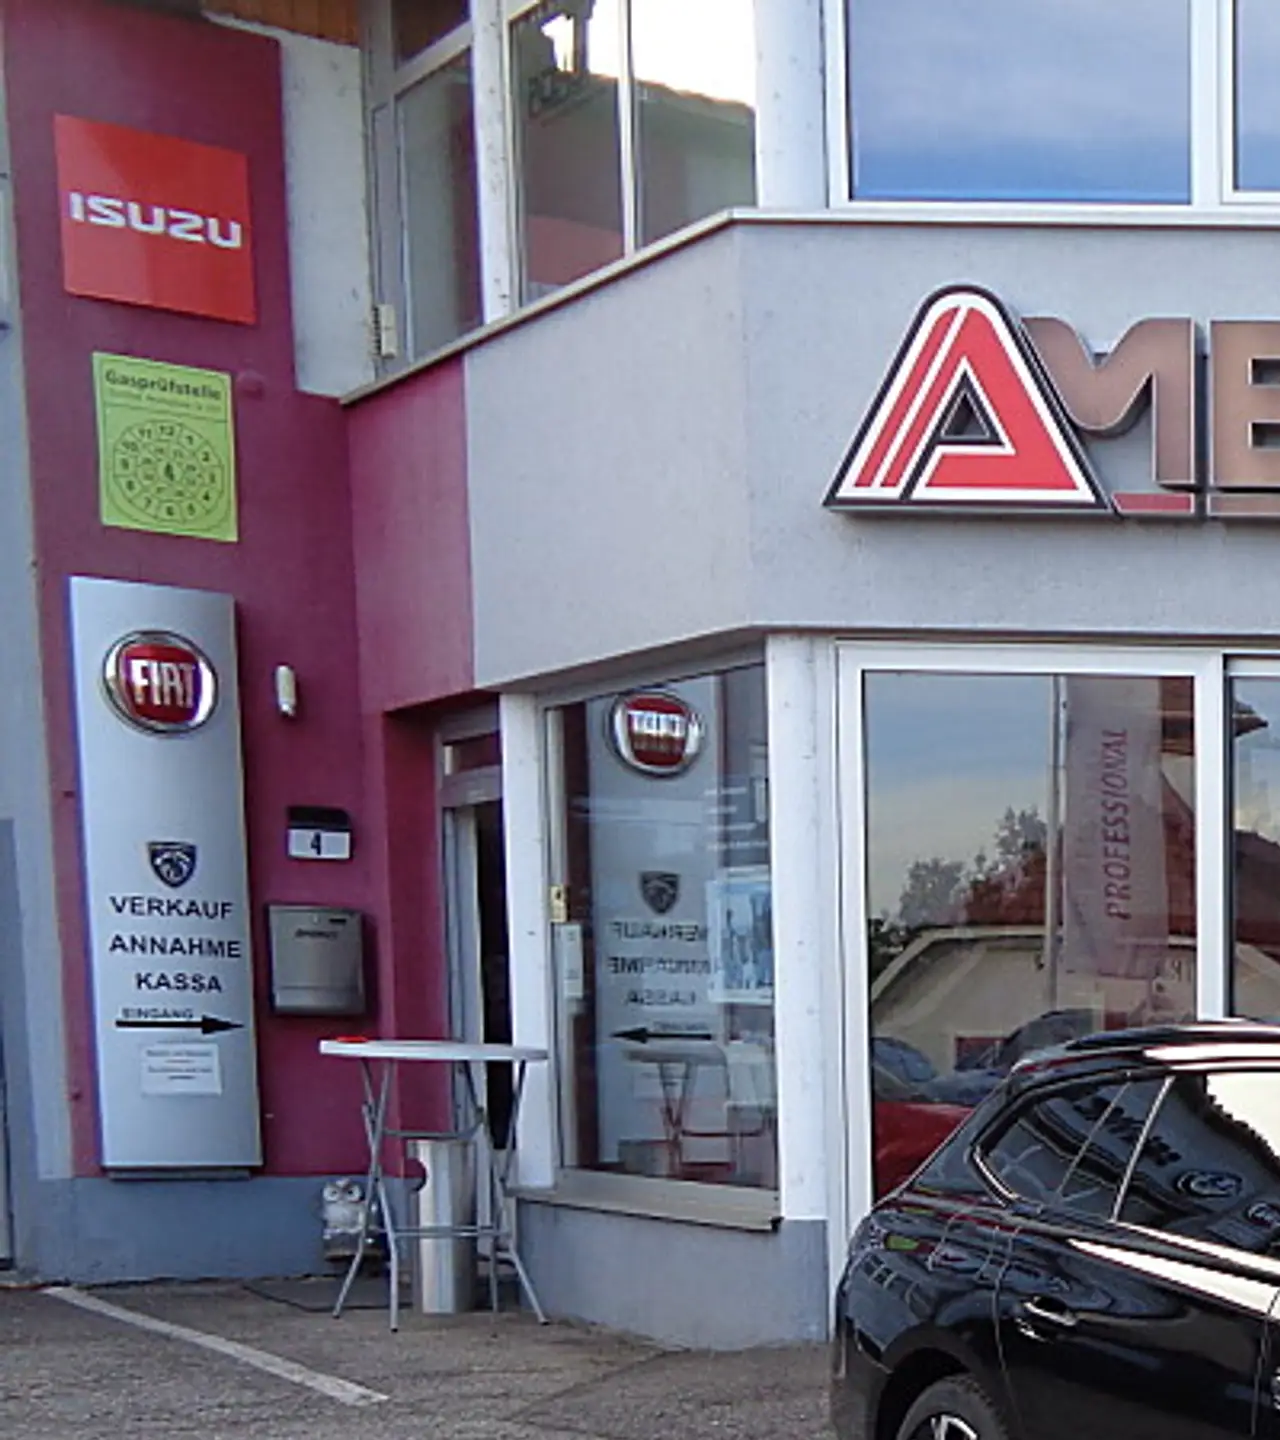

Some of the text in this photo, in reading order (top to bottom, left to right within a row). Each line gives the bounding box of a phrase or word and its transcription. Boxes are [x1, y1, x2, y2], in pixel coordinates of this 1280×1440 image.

[69, 191, 242, 249] ISUZU
[130, 658, 197, 709] FIAT
[1101, 728, 1132, 921] PROFESSIONAL
[310, 831, 322, 856] 4
[109, 896, 234, 920] VERKAUF
[109, 933, 242, 959] ANNAHME
[135, 972, 223, 994] KASSA
[121, 1006, 195, 1020] EINGANG
